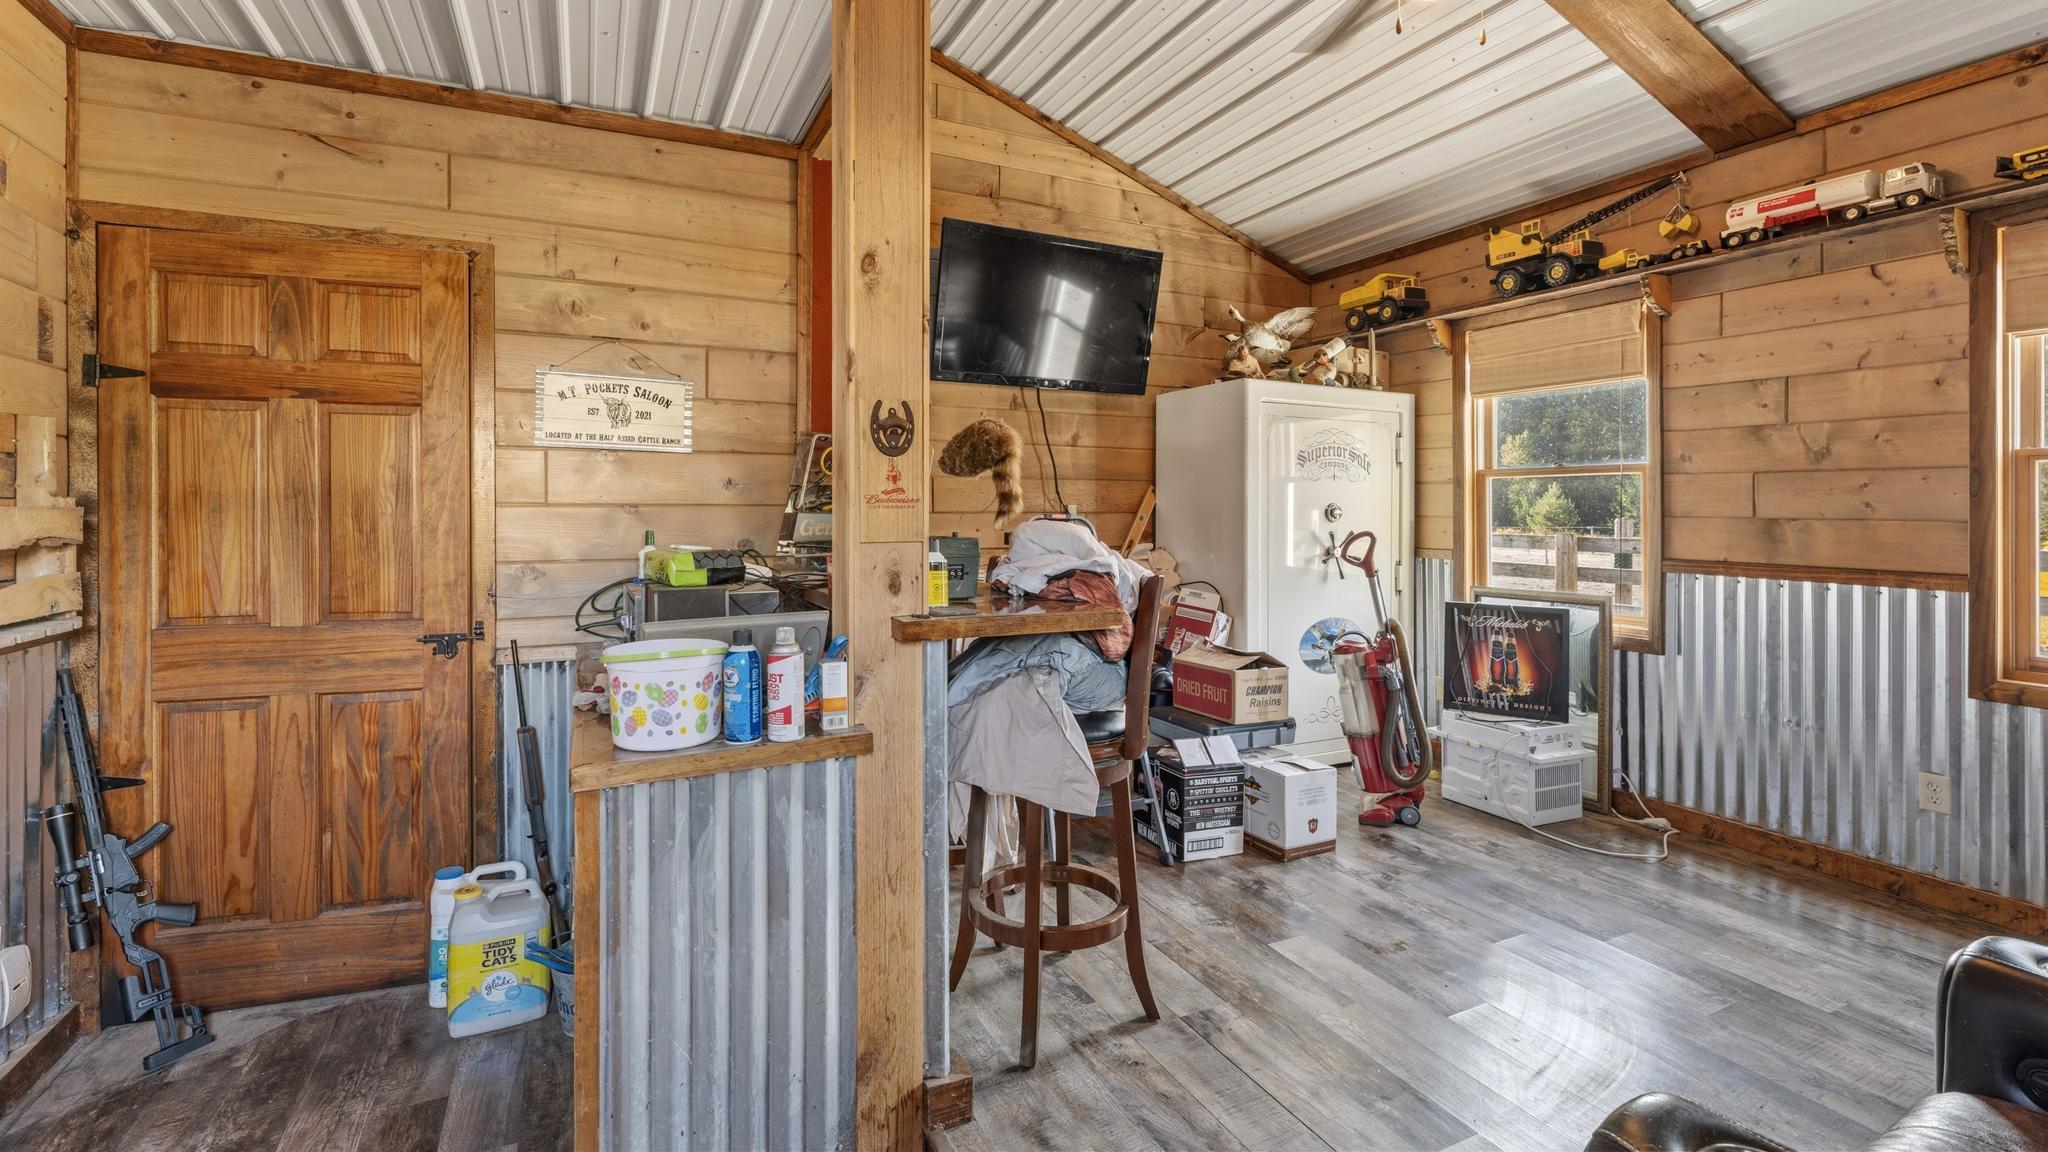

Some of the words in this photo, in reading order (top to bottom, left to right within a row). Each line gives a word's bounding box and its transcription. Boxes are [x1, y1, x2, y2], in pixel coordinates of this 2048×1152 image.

[584, 383, 630, 395] POCKETS
[633, 386, 673, 410] SALOON
[635, 410, 652, 420] 2021
[545, 431, 572, 440] LOCATED
[575, 432, 583, 440] AT
[586, 433, 596, 441] THE
[599, 433, 614, 441] HALF
[617, 434, 635, 442] ASSED
[638, 435, 660, 444] CATTLE
[662, 436, 681, 445] RANCH
[1296, 444, 1347, 468] Superior
[1348, 447, 1372, 475] Safe
[864, 494, 920, 504] Budweiser
[1177, 678, 1200, 697] DRIED
[1202, 683, 1228, 704] FRUIT
[1246, 684, 1283, 697] CHAMPION
[1250, 698, 1281, 708] Raisins
[1513, 703, 1545, 711] DESIGN
[482, 946, 515, 959] TIDY
[482, 954, 517, 968] CATS
